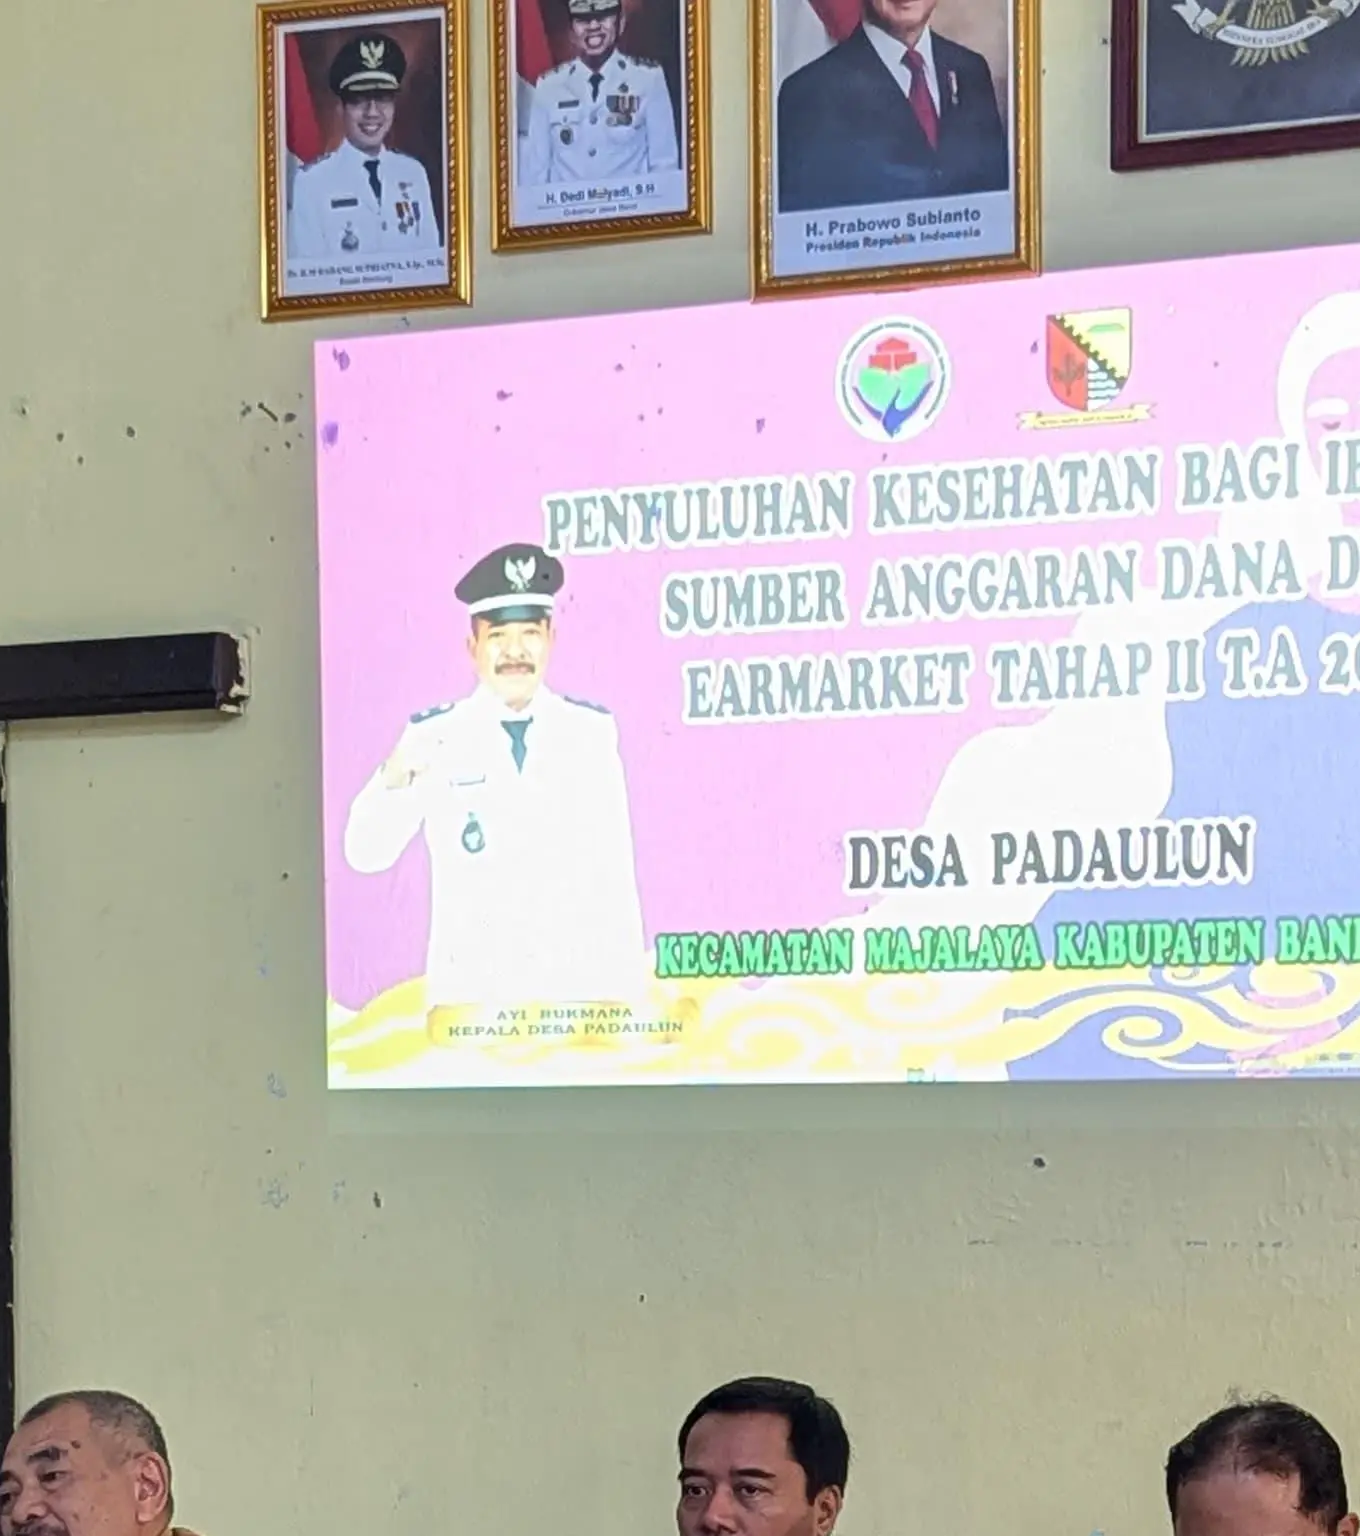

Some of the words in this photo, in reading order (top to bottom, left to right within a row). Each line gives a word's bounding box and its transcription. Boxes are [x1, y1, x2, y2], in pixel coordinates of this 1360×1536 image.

[805, 222, 824, 238] H.
[829, 216, 901, 236] Prabowo
[906, 208, 981, 228] Subianto
[806, 239, 859, 254] Presiden
[863, 233, 916, 249] Republik
[920, 226, 981, 242] Indonesia
[546, 476, 851, 551] PENYULUHAN
[873, 453, 1158, 529] KESEHATAN
[1181, 443, 1300, 507] BAGI
[664, 568, 846, 633] SUMBER
[866, 549, 1138, 620] ANGGARAN
[1160, 539, 1302, 601] DANA
[687, 651, 971, 720] EARMARKET
[992, 640, 1153, 704] TAHAP
[1166, 638, 1200, 694] II
[1224, 633, 1301, 692] T.A
[848, 833, 969, 890] DESA
[991, 822, 1251, 886] PADAULUN
[654, 928, 854, 979] KECAMATAN
[864, 922, 1045, 974] MAJALAYA
[1054, 916, 1266, 969] KABUPATEN
[448, 1024, 521, 1037] KEPALA
[527, 1024, 577, 1036] DESA
[584, 1021, 684, 1035] PADAULUN
[496, 1009, 528, 1021] AYI
